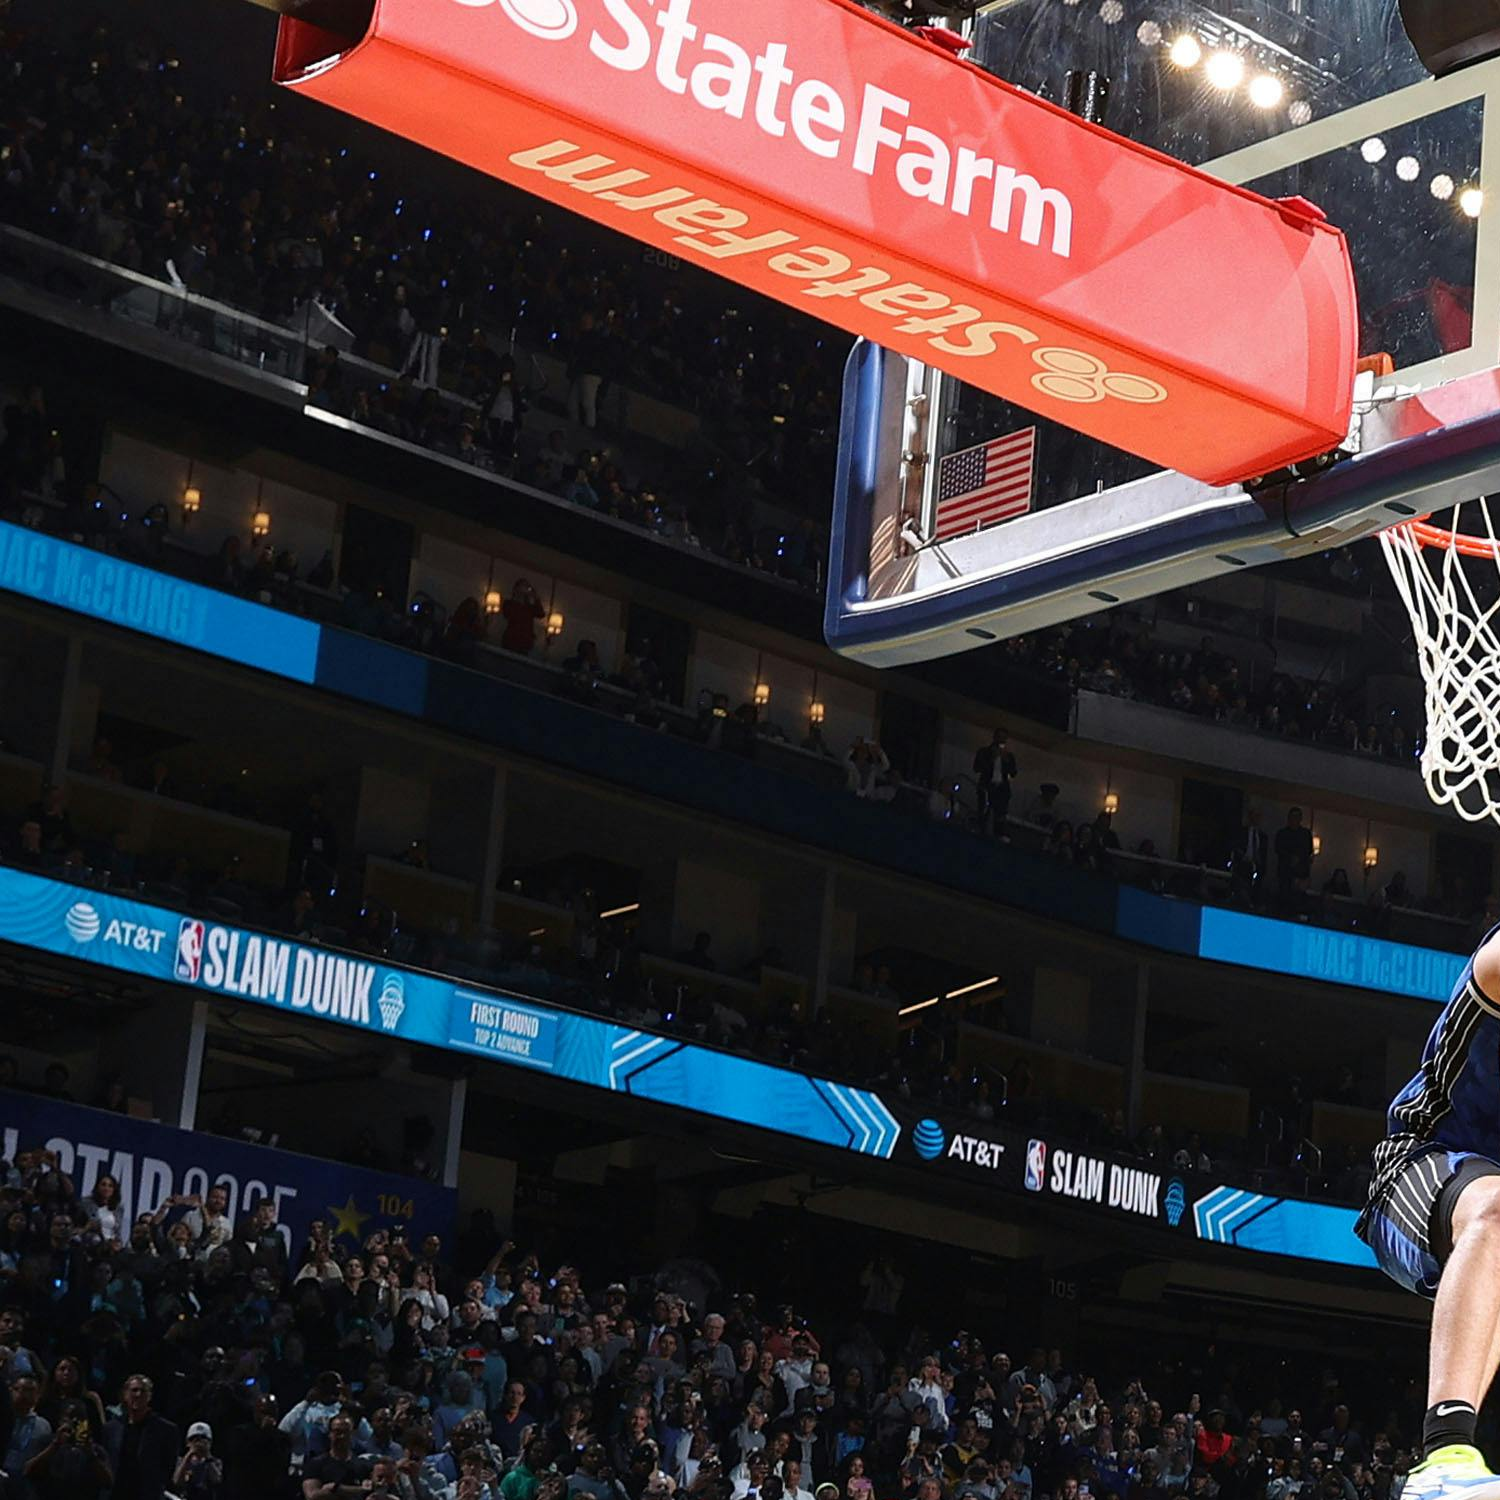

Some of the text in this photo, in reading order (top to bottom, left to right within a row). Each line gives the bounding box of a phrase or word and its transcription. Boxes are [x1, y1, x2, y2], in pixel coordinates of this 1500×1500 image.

[104, 919, 166, 954] AT&T
[1306, 930, 1356, 980] MAC
[204, 926, 375, 1025] SLAM DUNK
[470, 1001, 540, 1038] FIRST ROUND
[475, 1028, 491, 1045] TOP
[948, 1134, 1004, 1169] AT&T
[1050, 1149, 1161, 1217] SLAM DUNK
[377, 1193, 415, 1219] 104
